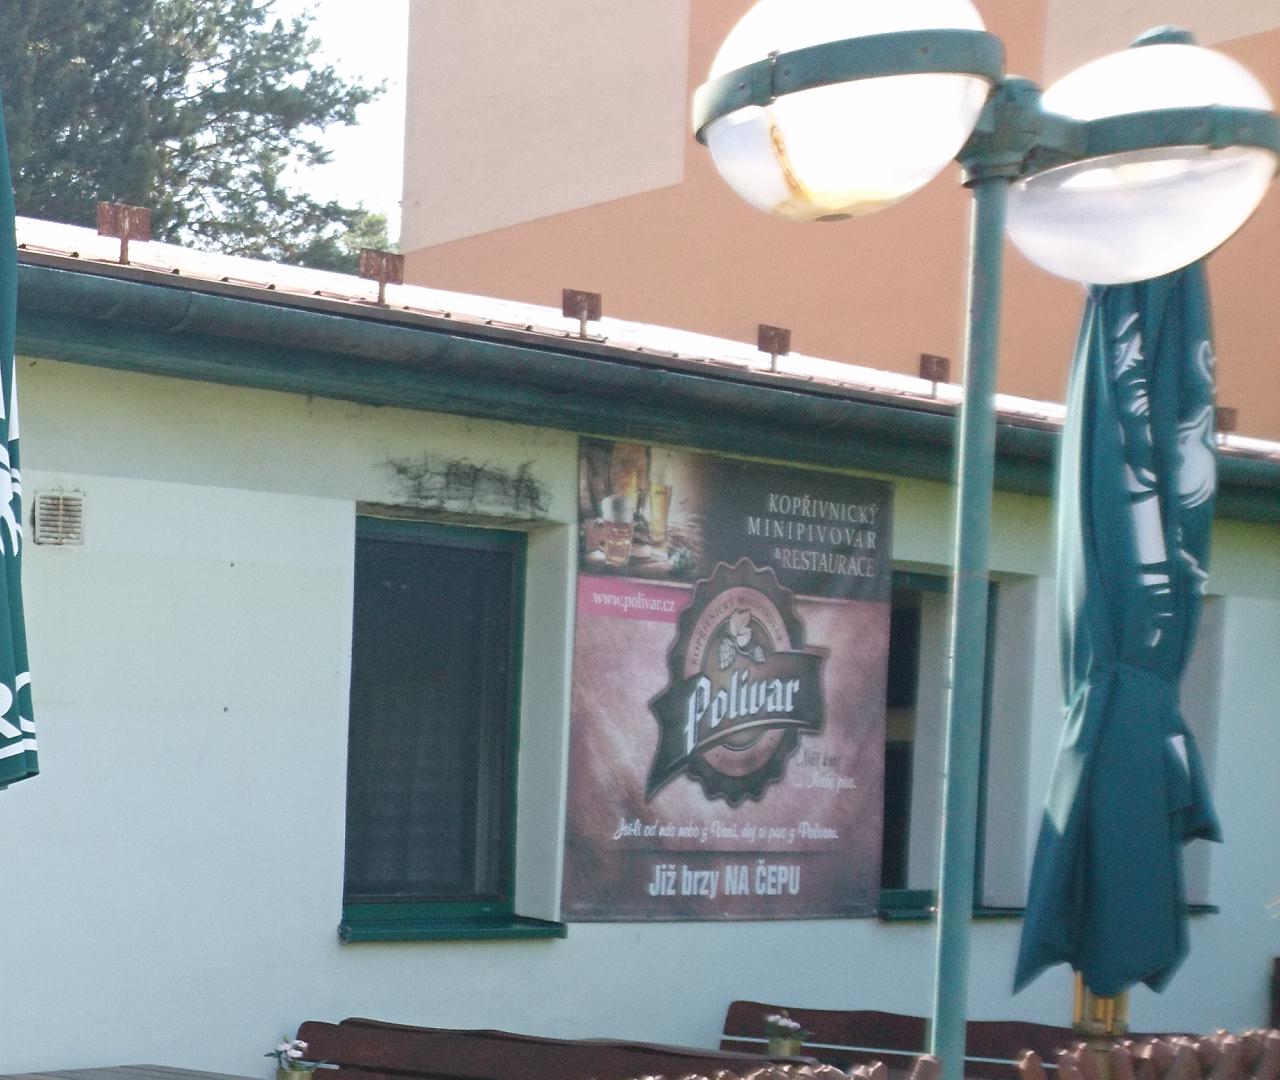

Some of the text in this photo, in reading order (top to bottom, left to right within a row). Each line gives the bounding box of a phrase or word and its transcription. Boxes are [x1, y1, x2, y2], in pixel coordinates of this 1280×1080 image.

[768, 493, 878, 525] KOPŘIVNICKÝ
[747, 516, 876, 549] MINIPIVOVAR
[593, 592, 676, 612] www.polivar.cz
[683, 669, 800, 755] Polivar
[649, 858, 801, 899] Již brzy NA ČEPU
